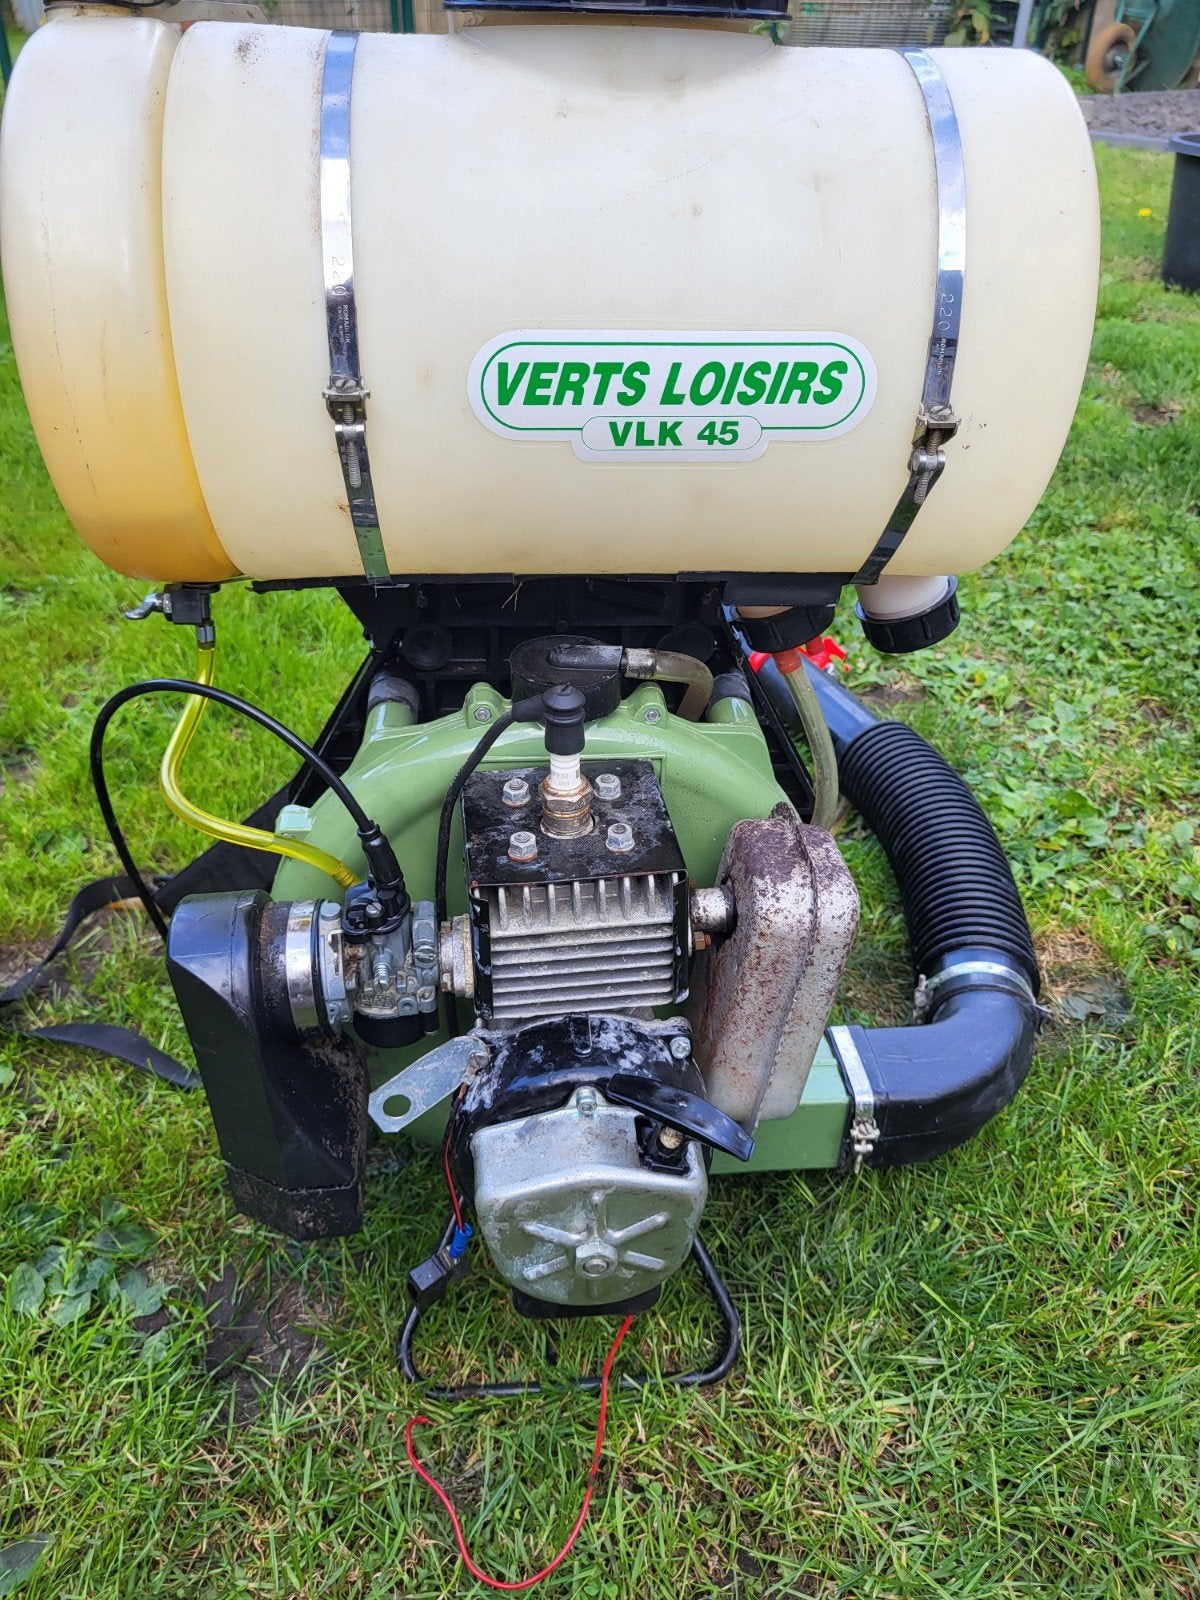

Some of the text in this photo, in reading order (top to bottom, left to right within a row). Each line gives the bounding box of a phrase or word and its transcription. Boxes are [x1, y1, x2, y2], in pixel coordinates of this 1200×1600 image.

[938, 293, 954, 331] 220
[497, 360, 849, 407] VERTS LOISIRS
[608, 420, 739, 447] VLK 45
